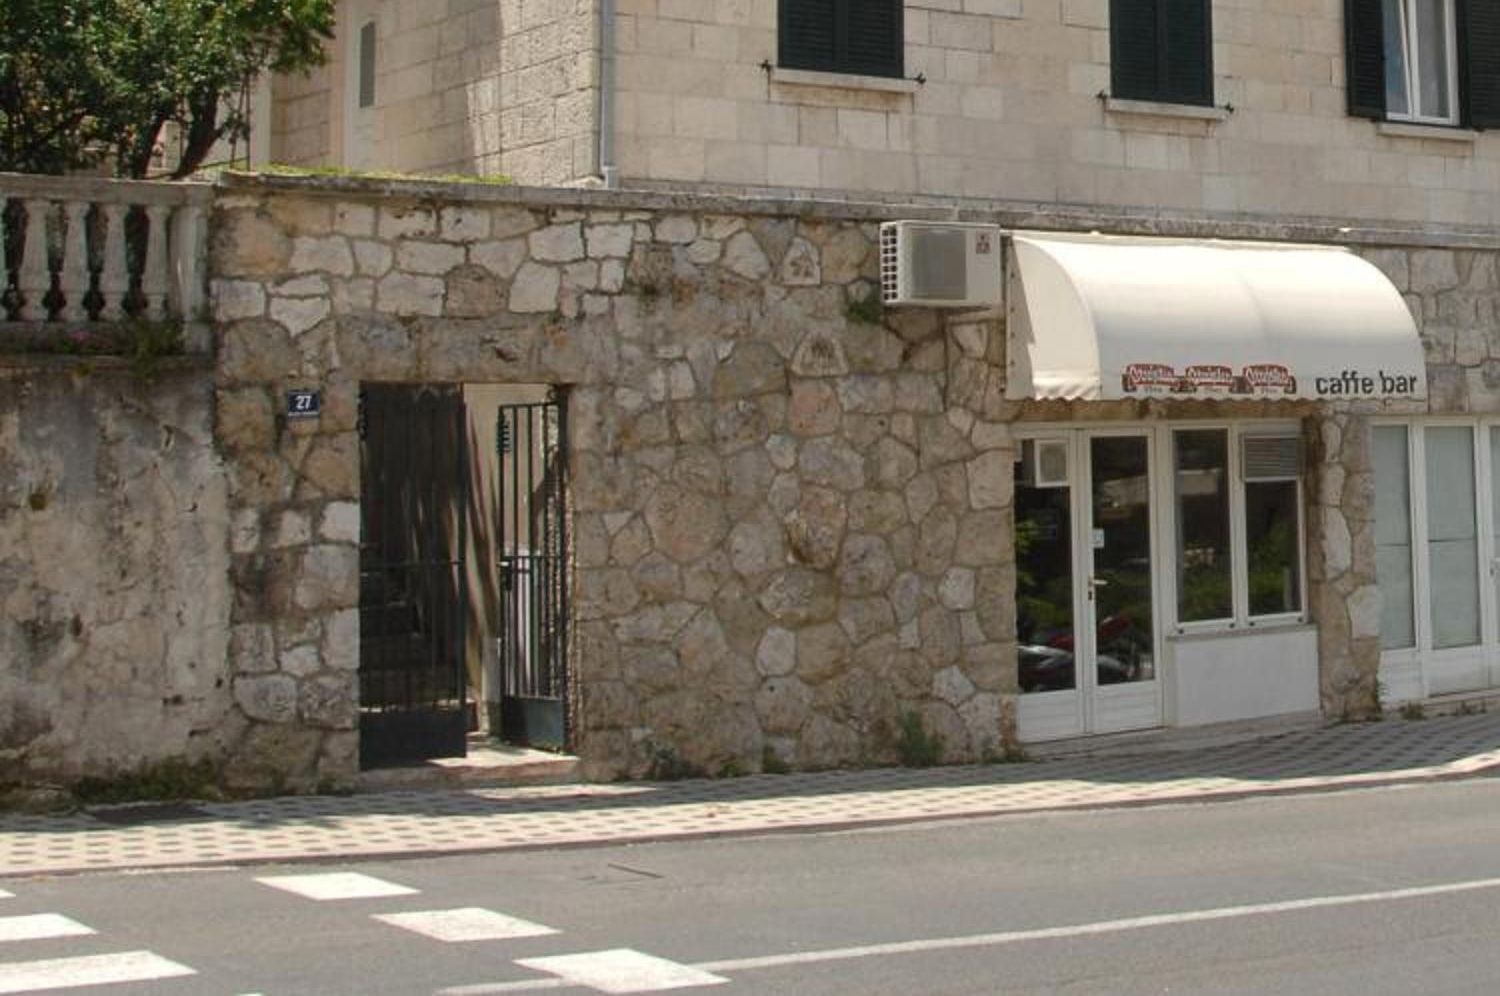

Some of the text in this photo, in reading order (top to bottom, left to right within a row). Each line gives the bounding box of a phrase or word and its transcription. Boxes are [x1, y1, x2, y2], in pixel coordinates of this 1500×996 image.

[1315, 370, 1375, 394] caffe
[1379, 370, 1417, 393] bar
[295, 395, 312, 410] 27
